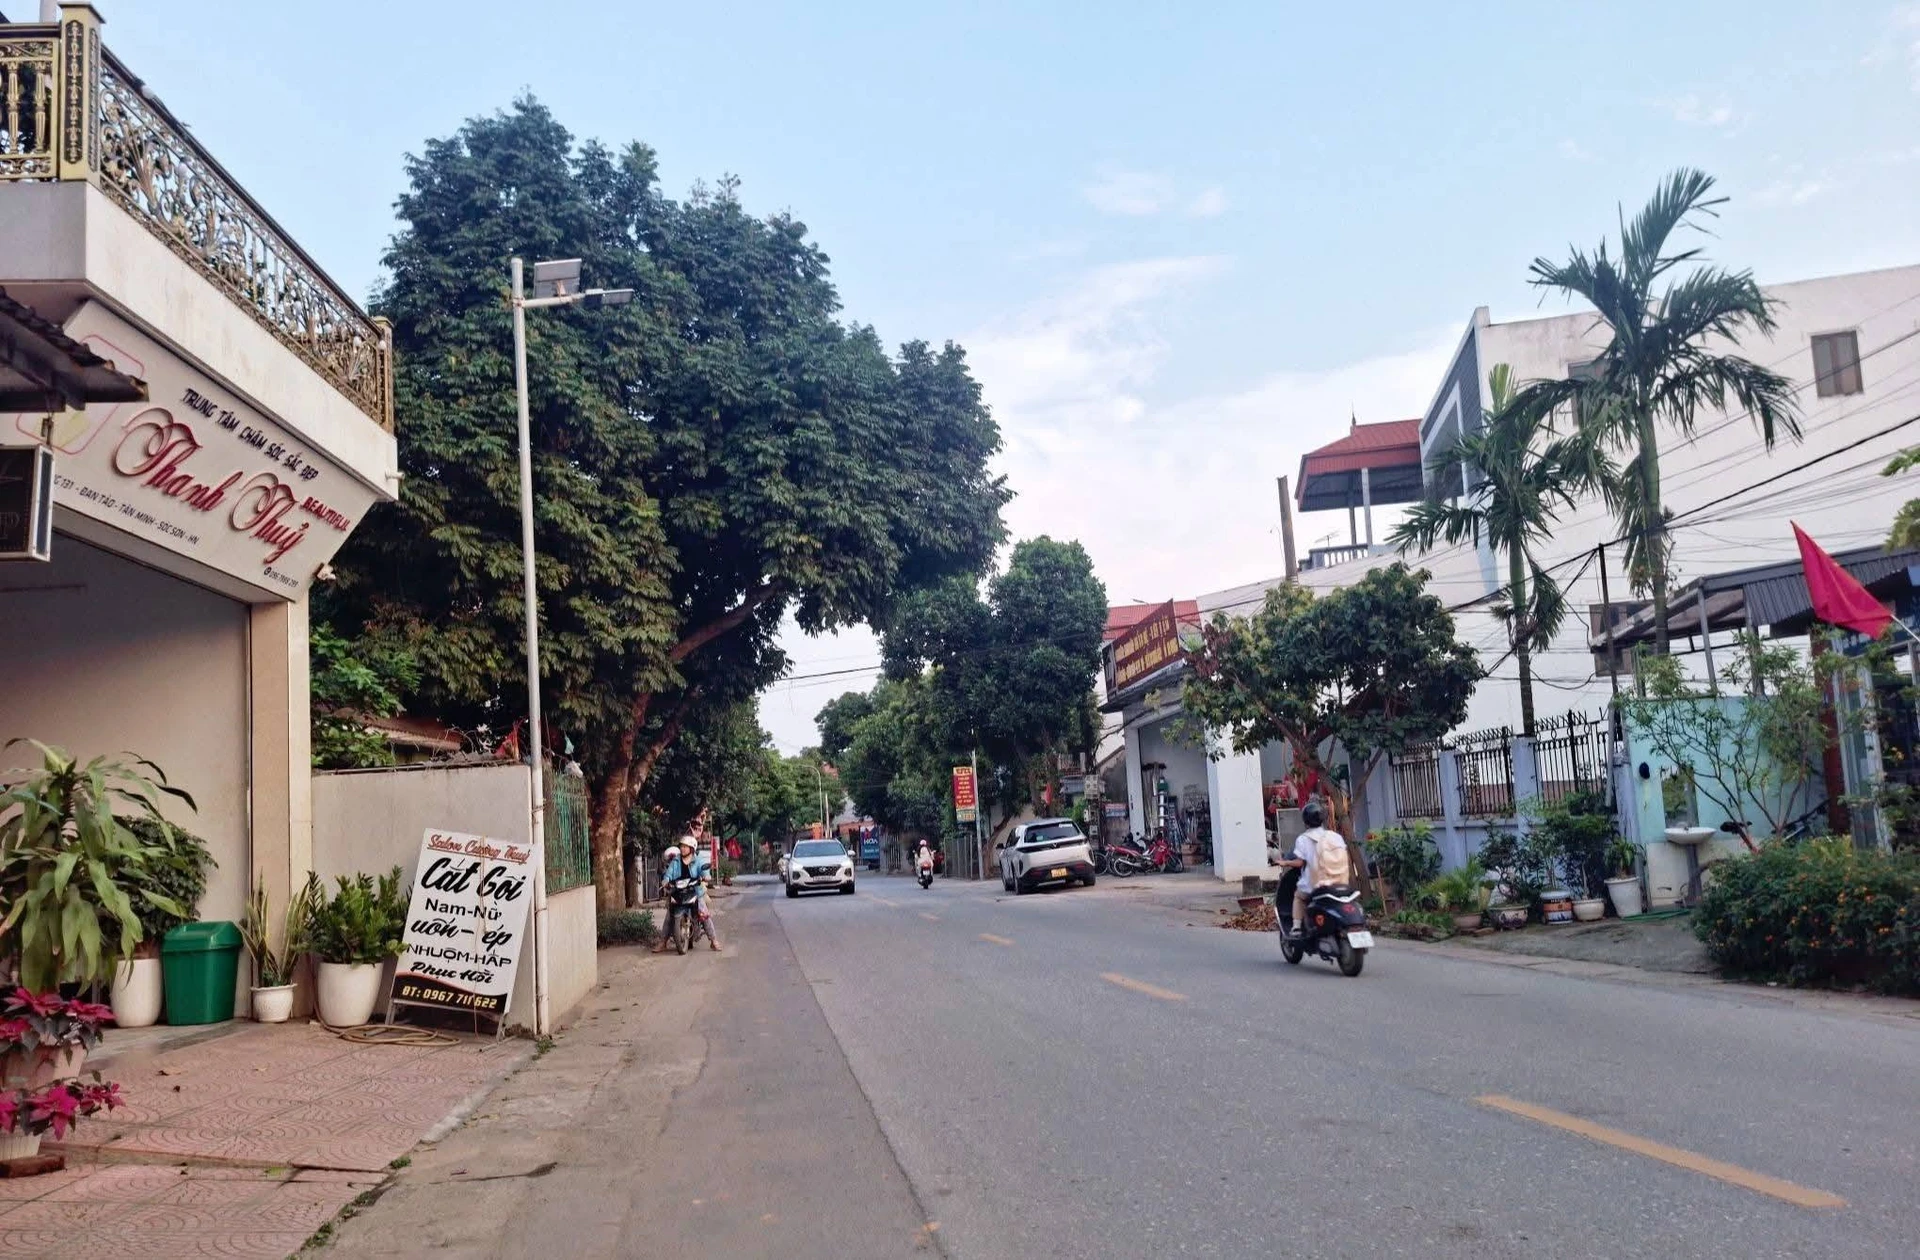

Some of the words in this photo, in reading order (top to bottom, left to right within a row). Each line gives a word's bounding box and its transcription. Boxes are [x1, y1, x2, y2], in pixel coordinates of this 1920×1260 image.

[182, 387, 218, 418] TRUNG
[216, 410, 240, 433] TÂM
[239, 426, 268, 450] CHĂM
[265, 442, 286, 461] SÓC
[283, 452, 303, 471] SẮC
[300, 465, 319, 481] ĐẸP
[112, 407, 245, 514] Thanh
[62, 478, 75, 490] 131
[133, 511, 155, 525] MINH
[187, 535, 200, 545] HN
[302, 496, 351, 531] BEAUTIFUL
[428, 834, 463, 851] Salon
[421, 858, 481, 893] Cắt
[481, 924, 513, 952] ép
[423, 988, 453, 1002] 0967
[474, 994, 498, 1009] 622
